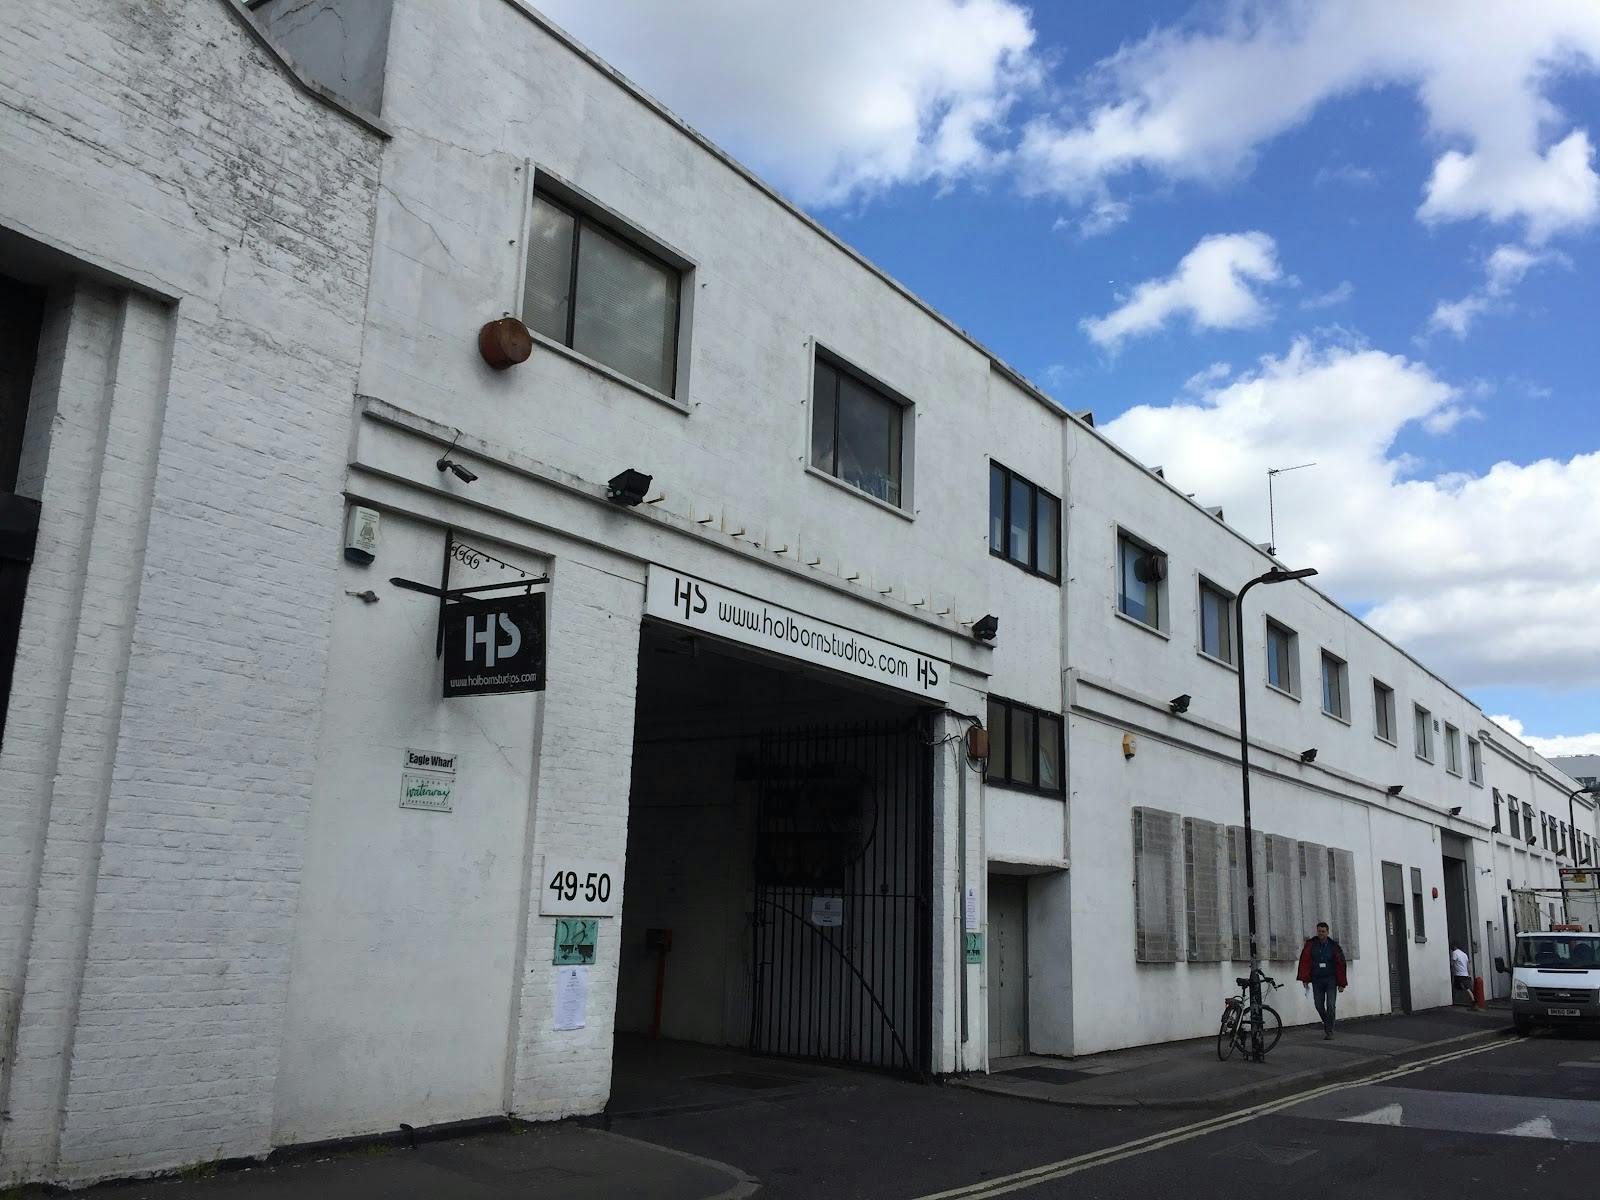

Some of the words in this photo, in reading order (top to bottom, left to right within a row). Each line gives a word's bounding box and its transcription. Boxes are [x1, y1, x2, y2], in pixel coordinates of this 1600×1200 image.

[465, 612, 521, 668] HS
[674, 577, 708, 619] HS
[718, 600, 908, 678] www.holbornstudios.com
[917, 657, 939, 689] HS
[450, 673, 537, 688] www.holbornstudios.com
[409, 752, 430, 766] Eagle
[431, 755, 453, 768] Wharf
